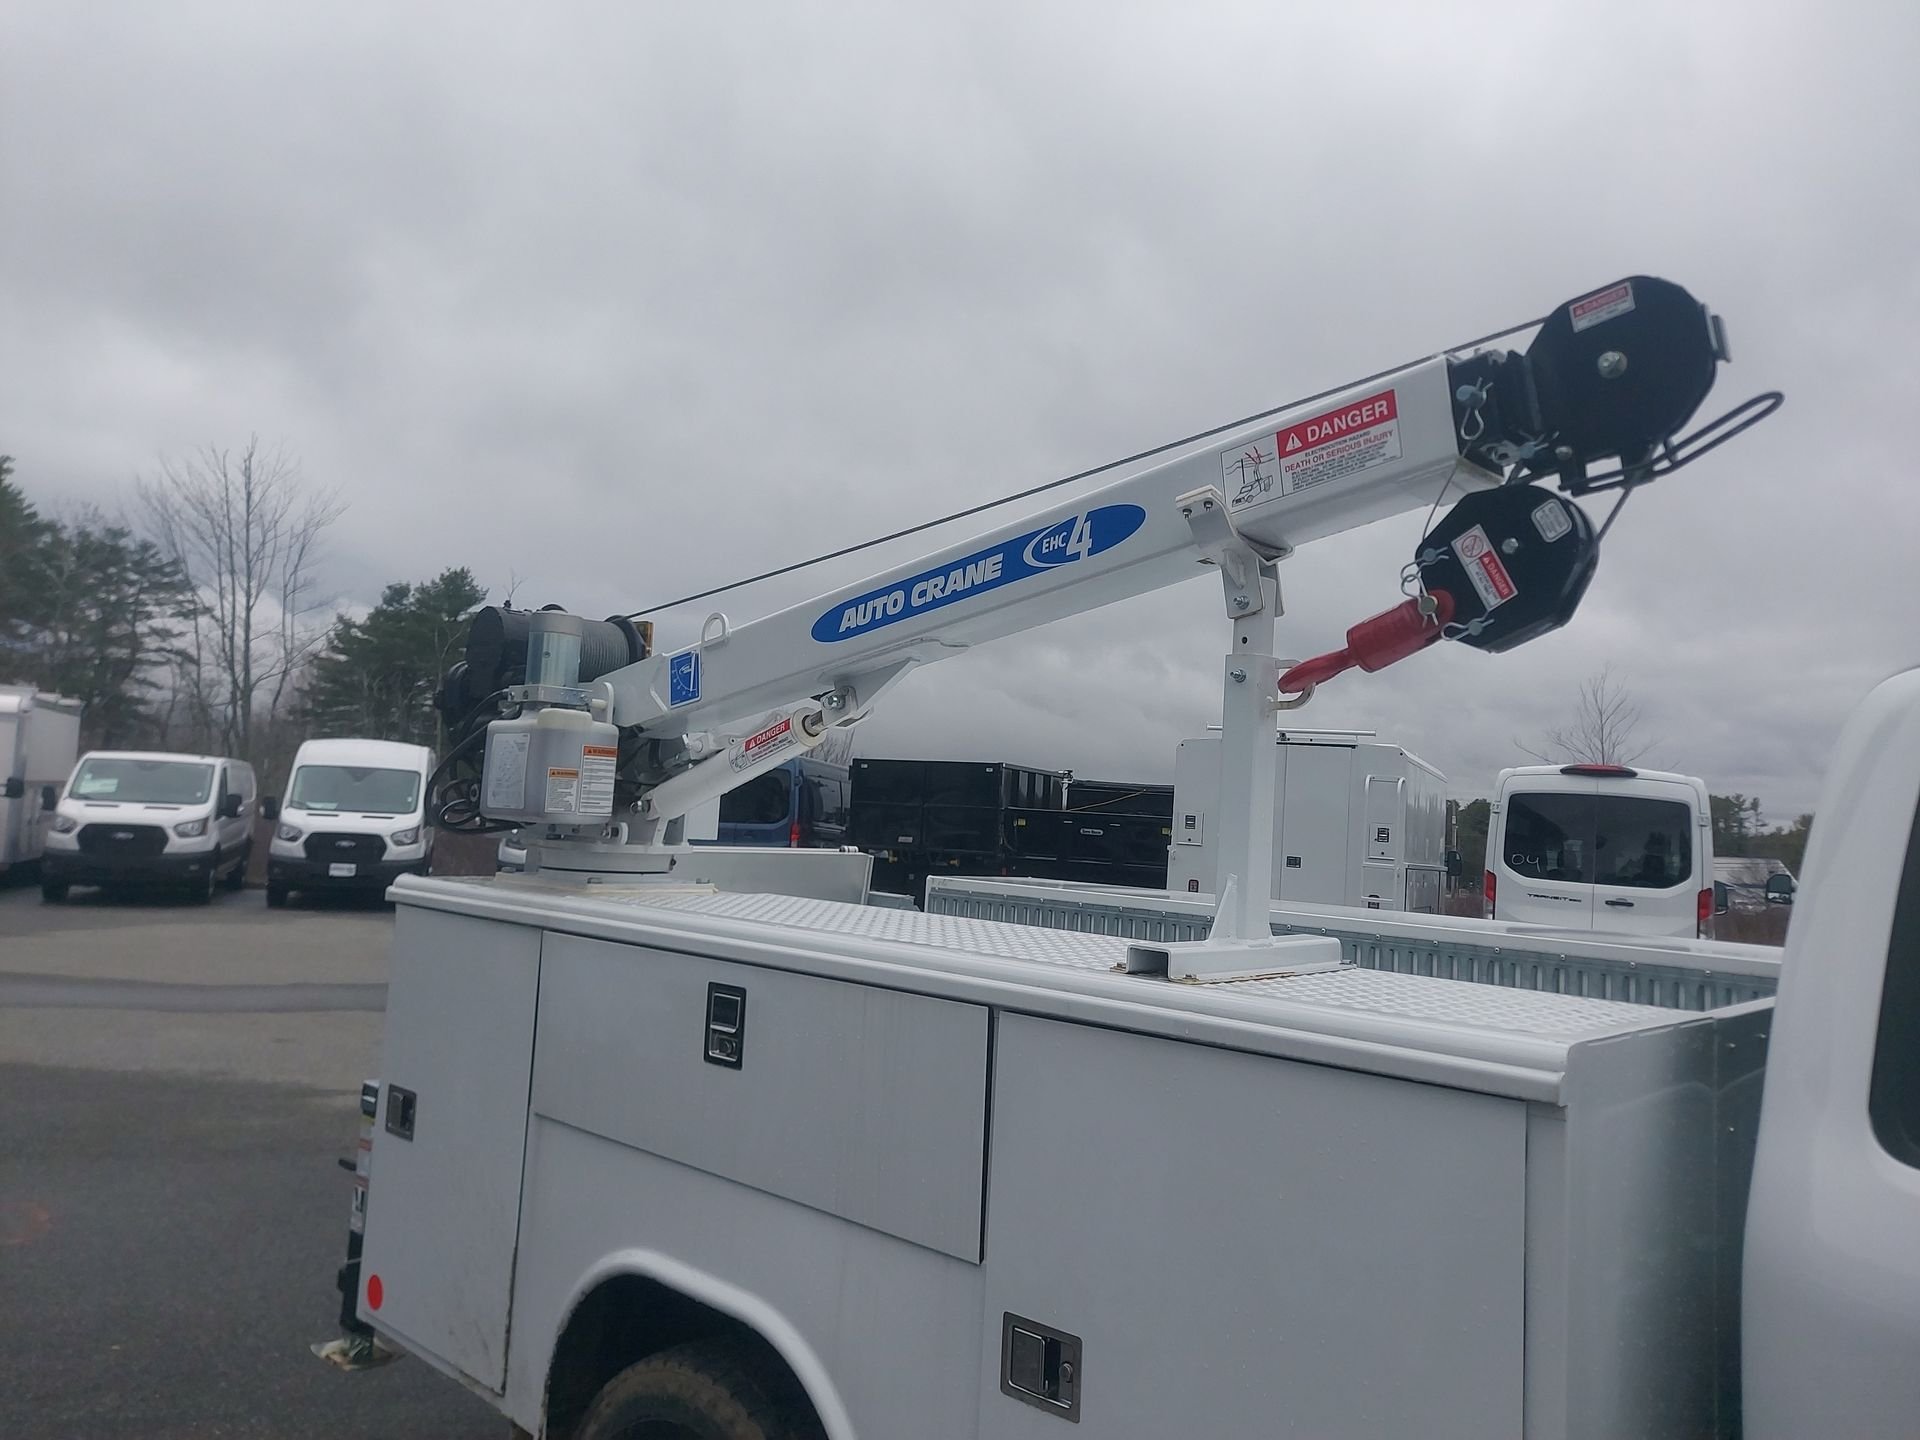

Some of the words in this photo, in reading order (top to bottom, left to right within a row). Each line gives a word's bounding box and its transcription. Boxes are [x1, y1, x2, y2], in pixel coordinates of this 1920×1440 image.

[1307, 400, 1389, 442] DANGER
[1285, 457, 1311, 473] DEATH
[1312, 453, 1325, 464] OR
[1326, 441, 1362, 460] SERIOUS
[1363, 429, 1394, 446] INJURY
[1042, 531, 1067, 554] EHC
[1066, 511, 1093, 561] 4
[839, 590, 905, 632] AUTO
[910, 553, 1004, 606] CRANE
[1486, 563, 1510, 595] DANGER
[756, 723, 786, 744] DANGER
[1511, 853, 1541, 873] 04
